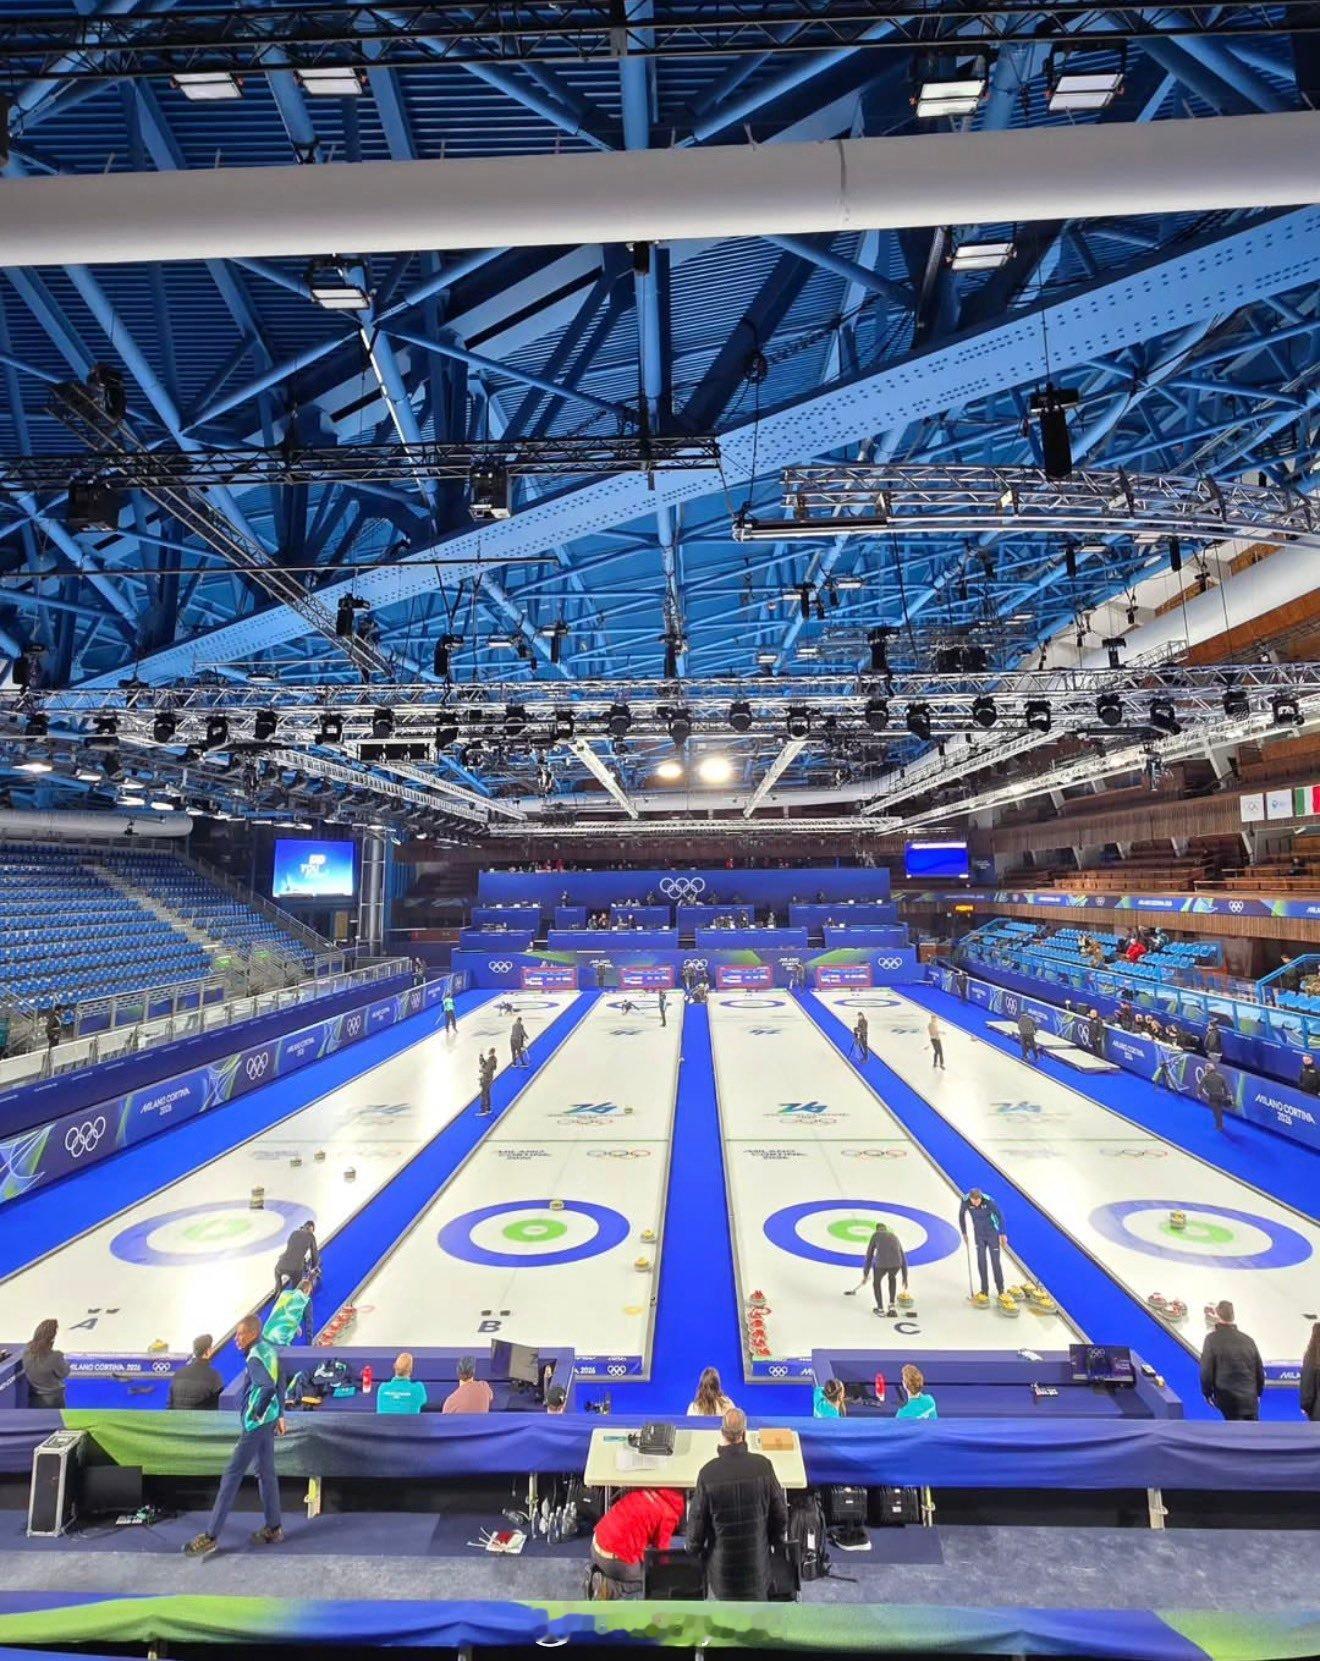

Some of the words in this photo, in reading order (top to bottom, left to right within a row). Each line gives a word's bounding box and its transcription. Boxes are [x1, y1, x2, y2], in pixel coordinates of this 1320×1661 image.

[1255, 1094, 1283, 1111] MILANO
[1284, 1104, 1315, 1124] CORTINA
[69, 1318, 98, 1330] A
[478, 1320, 501, 1332] B
[894, 1322, 921, 1334] C
[95, 1363, 125, 1371] CORTINA
[1280, 1371, 1301, 1379] MILA
